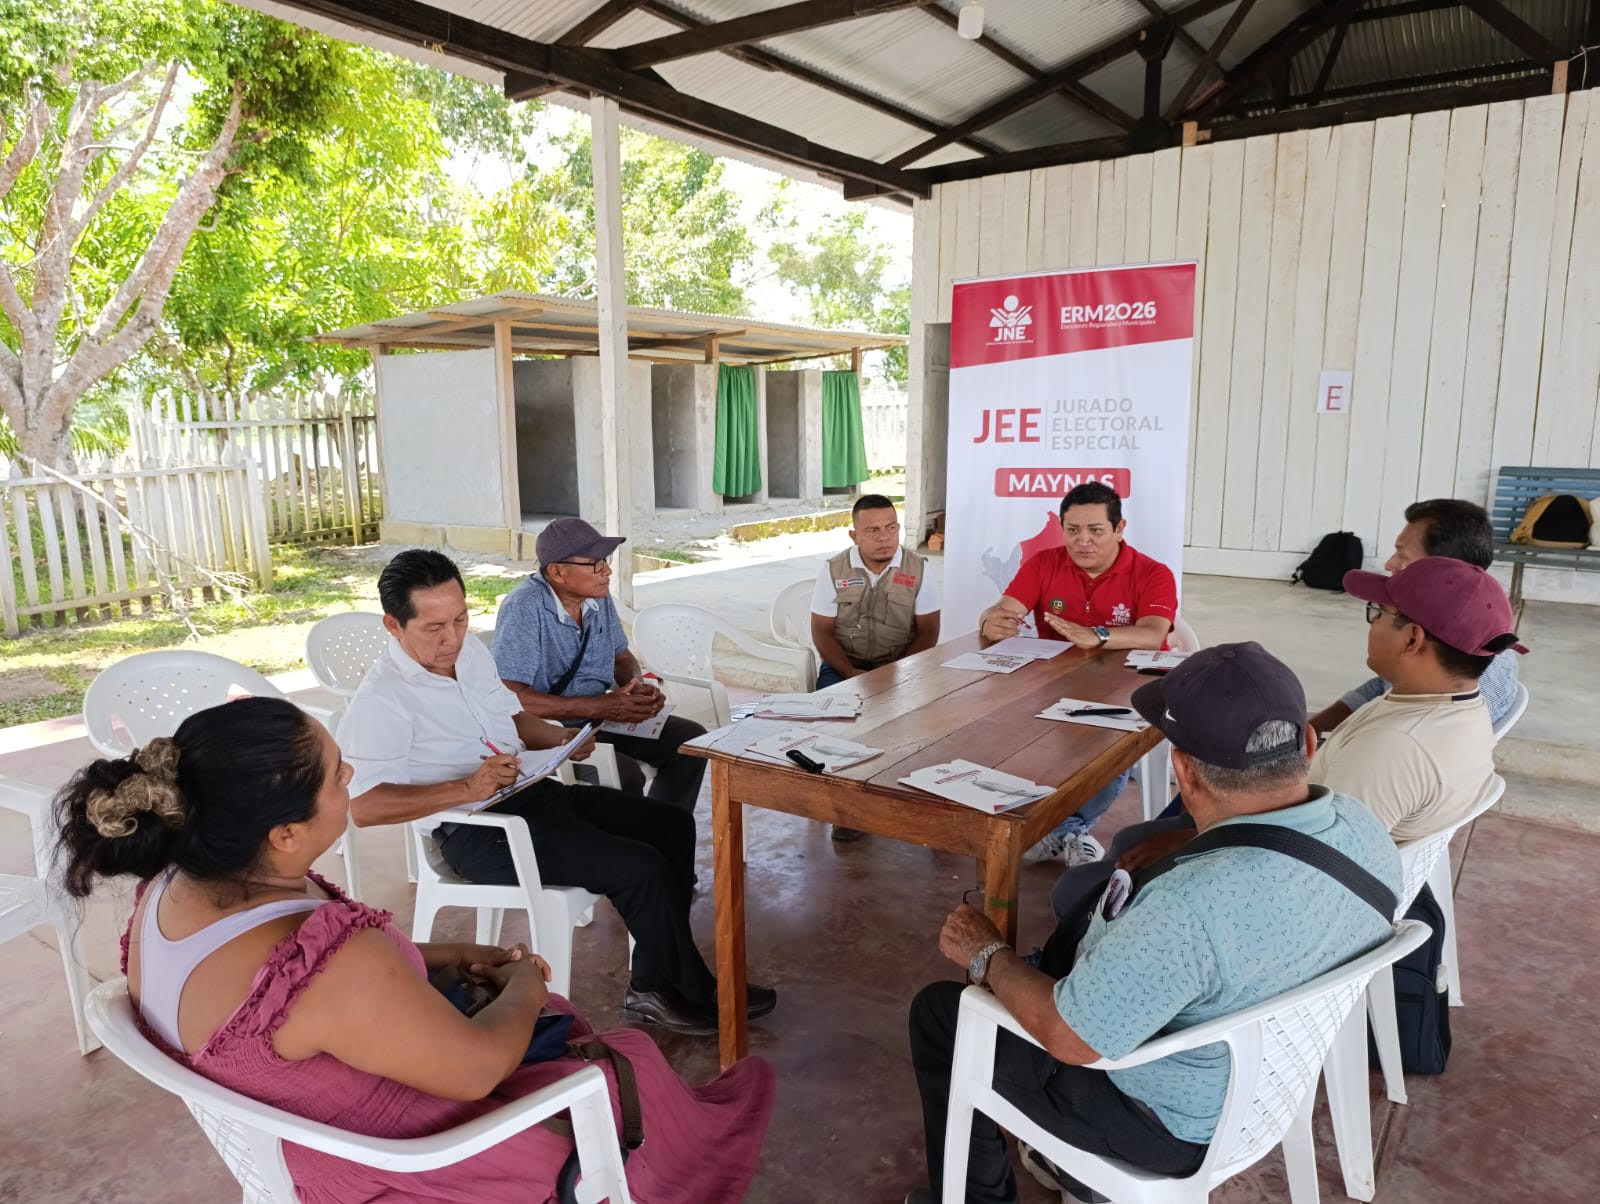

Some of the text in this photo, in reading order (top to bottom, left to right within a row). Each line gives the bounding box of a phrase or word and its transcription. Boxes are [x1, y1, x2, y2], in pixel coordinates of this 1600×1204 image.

[1061, 301, 1157, 324] ERM2026
[994, 325, 1026, 341] JNE
[1053, 398, 1132, 414] JURADO
[1326, 385, 1344, 410] E
[973, 408, 1041, 443] JEE
[1052, 415, 1164, 432] ELECTORAL
[1051, 434, 1141, 450] ESPECIAL
